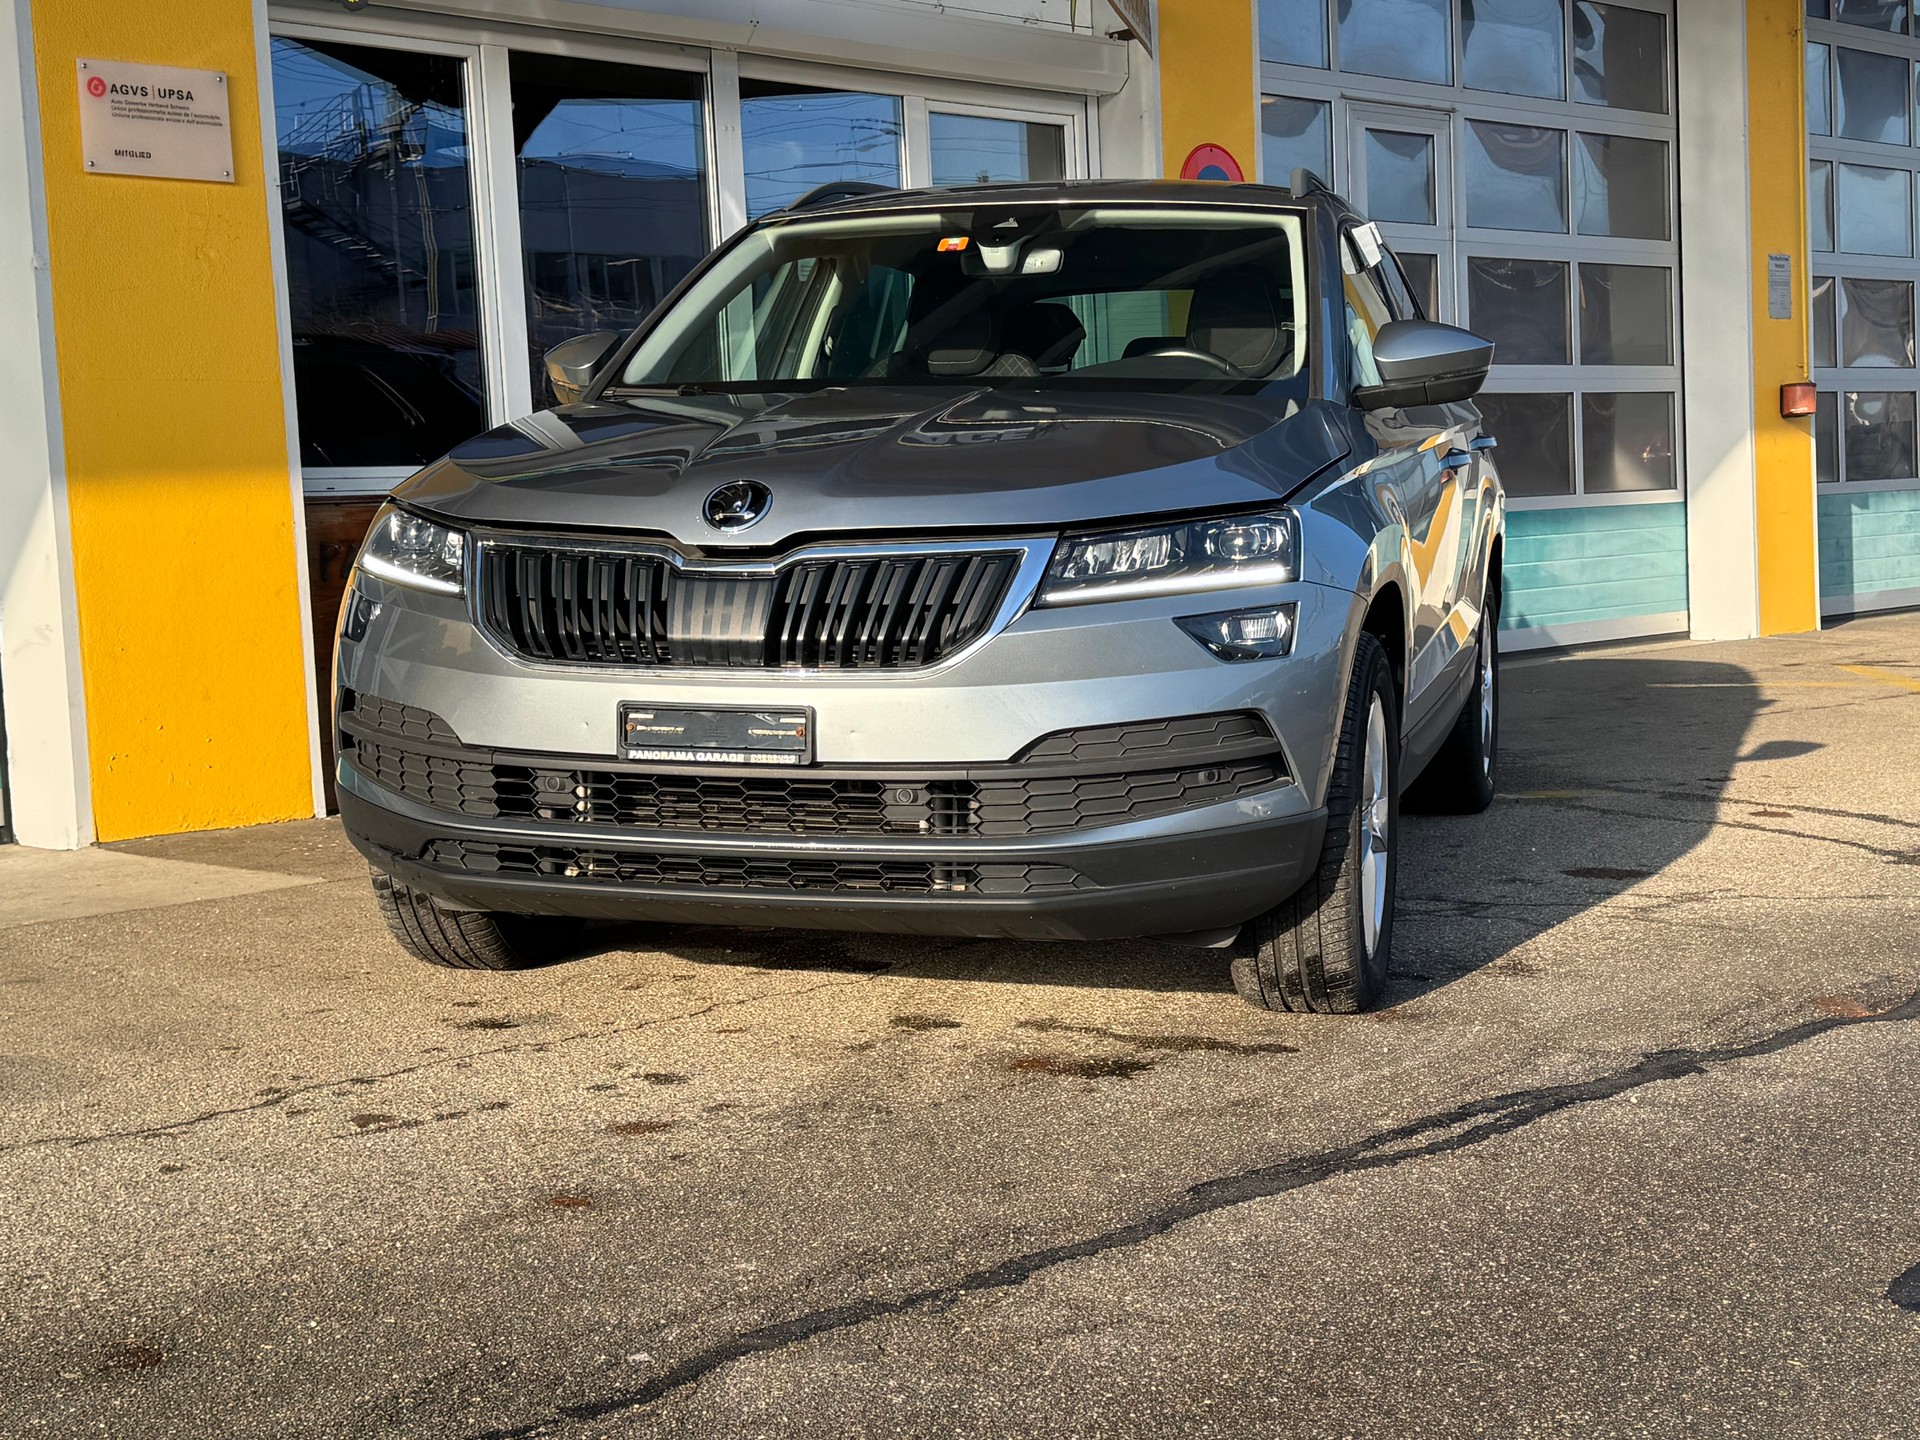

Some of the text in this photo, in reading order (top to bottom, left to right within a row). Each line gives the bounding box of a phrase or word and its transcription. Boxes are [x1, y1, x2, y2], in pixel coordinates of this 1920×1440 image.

[110, 84, 194, 102] AGVS UPSA
[114, 149, 152, 159] MITGLIED
[628, 750, 695, 761] PANORAMA
[696, 752, 744, 763] GARAGE
